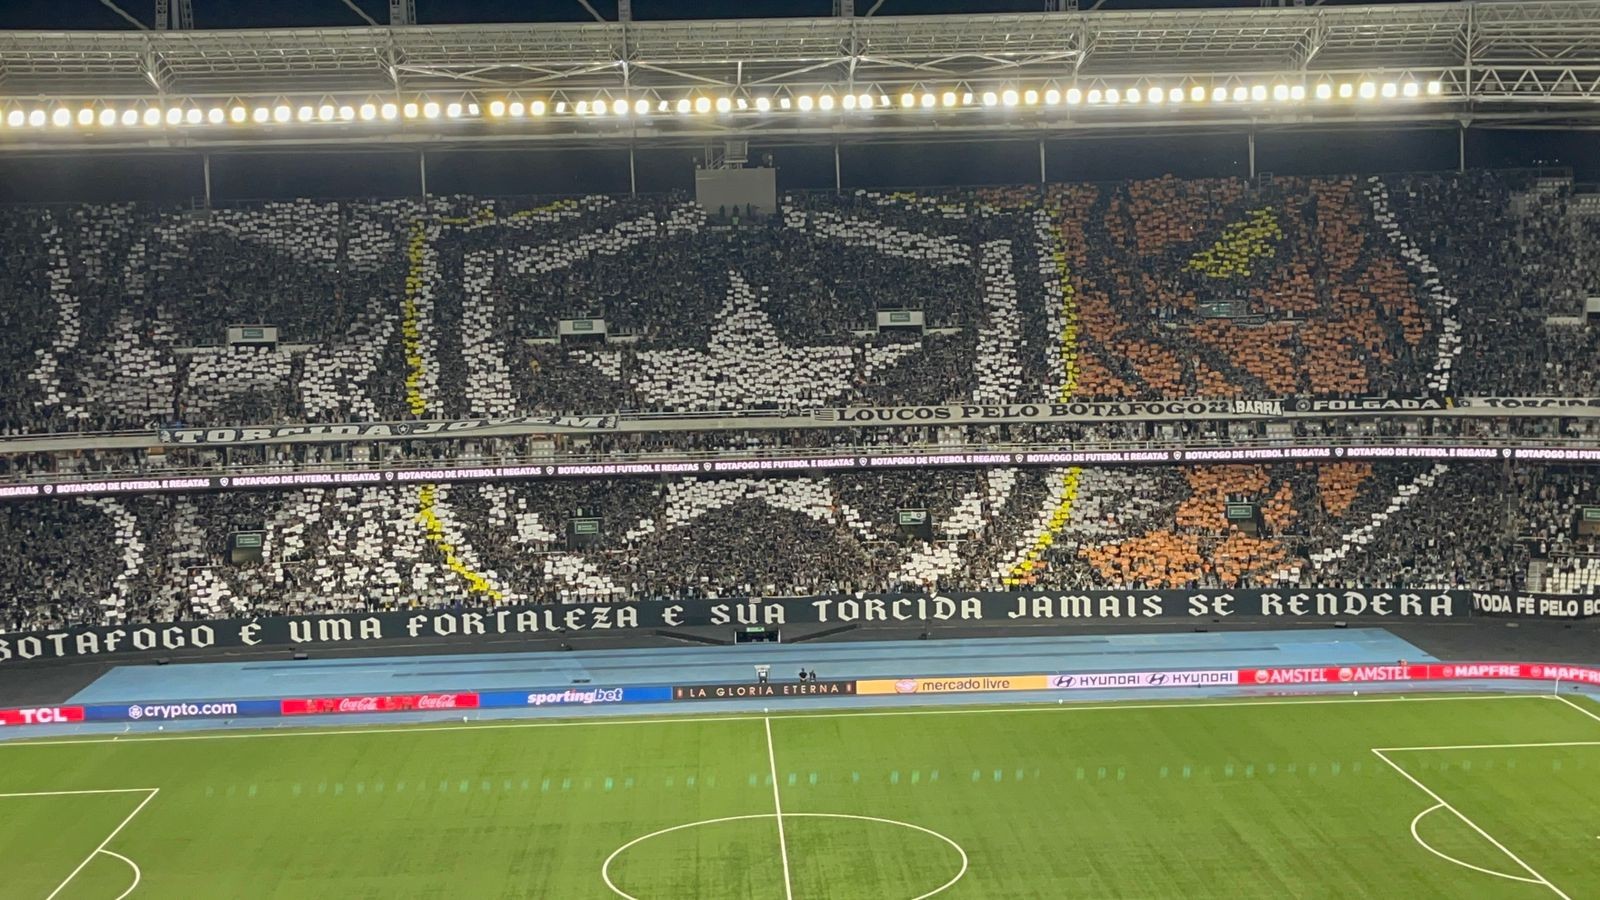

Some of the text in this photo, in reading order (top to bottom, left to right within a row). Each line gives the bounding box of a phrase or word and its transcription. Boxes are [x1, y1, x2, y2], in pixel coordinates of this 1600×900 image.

[1235, 400, 1282, 415] BARRA
[1313, 399, 1441, 410] FOLGADA
[837, 407, 950, 420] LOUCOS
[961, 405, 1039, 418] PELO
[1050, 402, 1206, 416] BOTAFOGO
[175, 425, 391, 442] TORCIDA
[1027, 454, 1071, 462] BOTAFOGO
[1086, 453, 1123, 461] FUTEBOL
[1131, 452, 1168, 460] REGATAS
[1185, 451, 1230, 459] BOTAFOGO
[1245, 450, 1283, 458] FUTEBOL
[1284, 449, 1290, 457] E
[1347, 448, 1394, 456] BOTAFOGO
[1396, 448, 1408, 456] DE
[1409, 448, 1448, 456] FUTEBOL
[1456, 449, 1498, 457] REGATAS
[1515, 450, 1564, 458] BOTAFOGO
[715, 462, 759, 470] BOTAFOGO
[774, 460, 809, 468] FUTEBOL
[818, 459, 854, 467] REGATAS
[871, 457, 915, 465] BOTAFOGO
[398, 471, 444, 479] BOTAFOGO
[458, 469, 495, 477] FUTEBOL
[503, 467, 540, 475] REGATAS
[558, 466, 602, 474] BOTAFOGO
[233, 476, 280, 485] BOTAFOGO
[294, 475, 333, 483] FUTEBOL
[334, 474, 340, 482] E
[342, 473, 380, 481] REGATAS
[57, 483, 106, 493] BOTAFOGO
[108, 482, 120, 490] DE
[121, 481, 161, 489] FUTEBOL
[170, 479, 210, 487] REGATAS
[1472, 593, 1512, 612] TODA
[1517, 595, 1535, 614] FÉ
[1540, 599, 1578, 616] PELO
[239, 617, 262, 645] É
[289, 617, 382, 643] UMA
[407, 606, 638, 637] FORTALEZA
[661, 605, 684, 626] E
[711, 603, 785, 625] SUA
[812, 596, 982, 622] TORCIDA
[1008, 595, 1162, 618] JAMAIS
[1188, 594, 1234, 616] SE
[1261, 590, 1452, 616] RENDERÁ
[1173, 672, 1232, 683] HYUNDAI
[1270, 668, 1328, 683] AMSTEL
[1352, 666, 1411, 681] AMSTEL
[1455, 665, 1520, 678] MAPFRE
[922, 678, 1010, 690] mercado livre
[1080, 675, 1139, 686] HYUNDAI
[528, 688, 623, 705] sportingbet
[690, 684, 839, 698] LA GLORIA ETERNA
[19, 708, 67, 724] TCL
[144, 703, 237, 718] crypto.com
